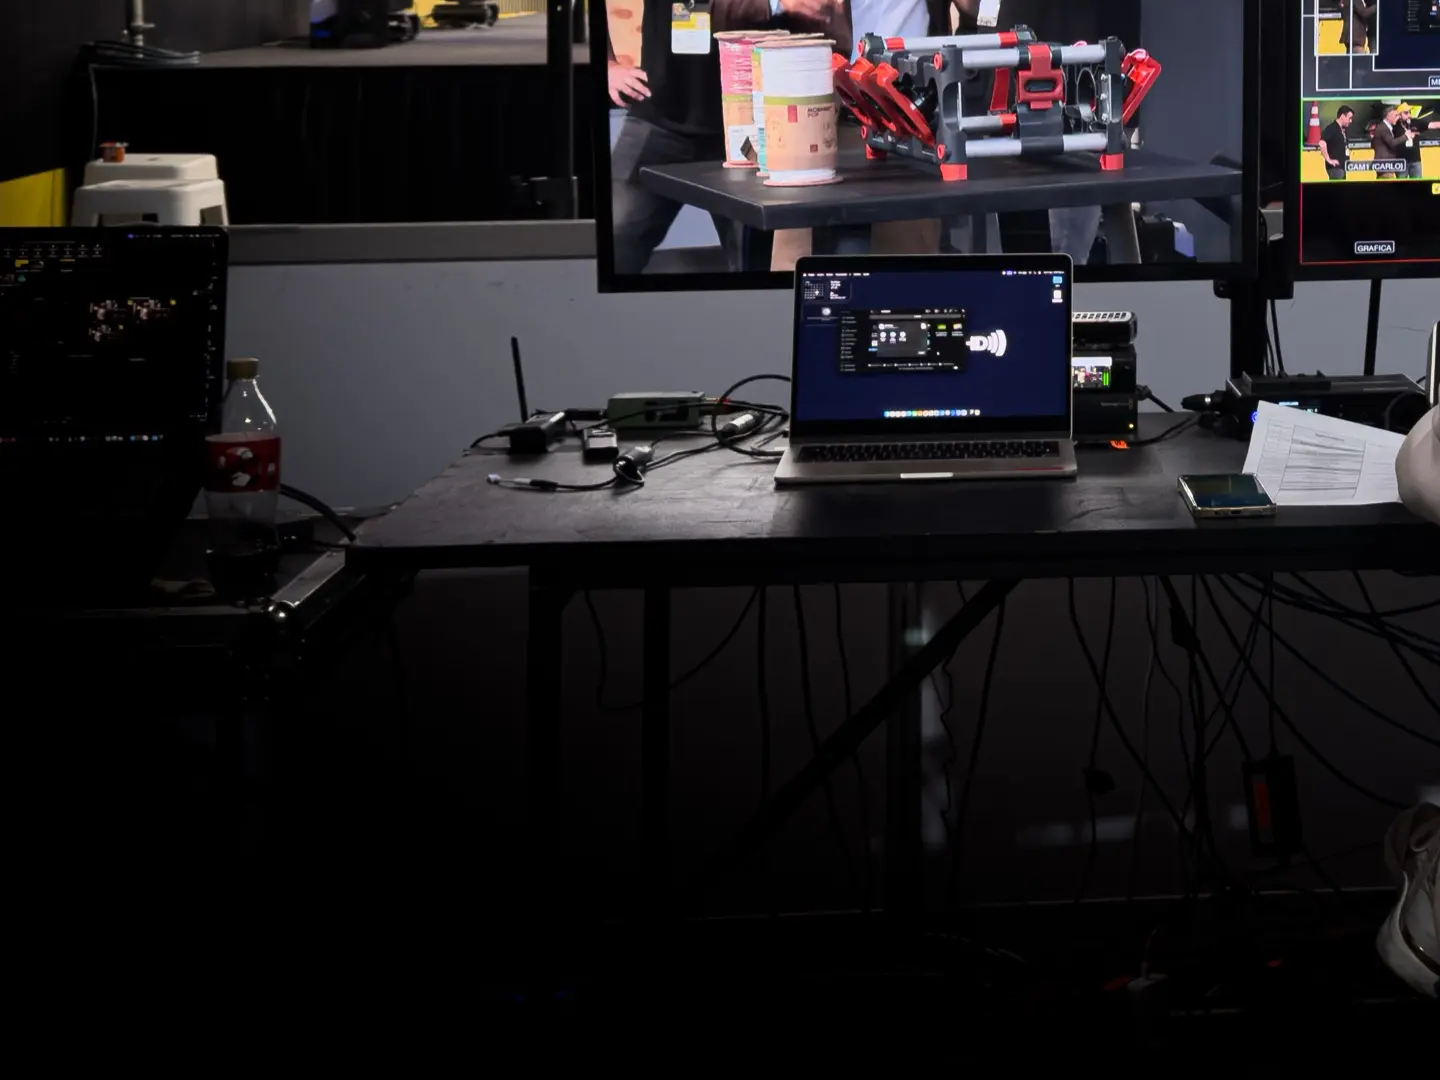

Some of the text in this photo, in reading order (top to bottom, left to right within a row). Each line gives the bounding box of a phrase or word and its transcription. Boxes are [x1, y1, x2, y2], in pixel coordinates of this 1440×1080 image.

[1347, 162, 1404, 171] CAM1 (CARLO)
[1357, 244, 1393, 252] GRAFICA
